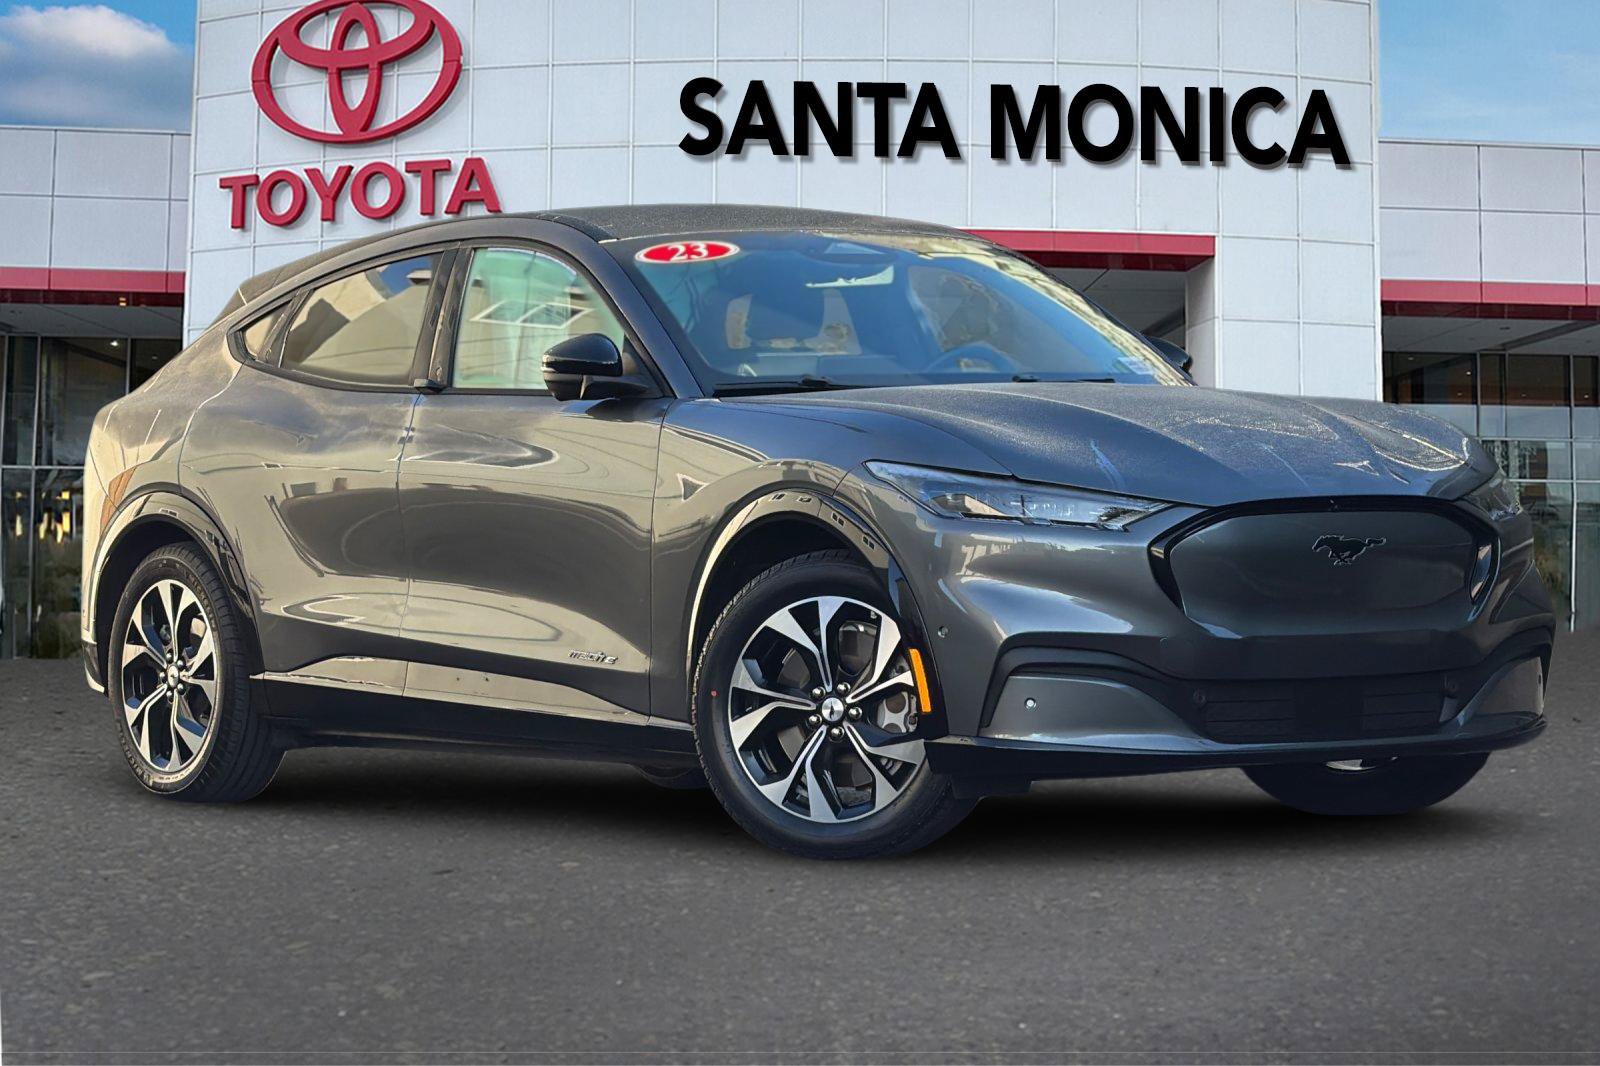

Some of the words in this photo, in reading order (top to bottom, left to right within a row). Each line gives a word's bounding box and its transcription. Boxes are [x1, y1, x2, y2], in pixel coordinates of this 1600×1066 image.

[678, 76, 961, 159] SANTA
[991, 83, 1351, 168] MONICA
[219, 157, 502, 229] TOYOTA
[667, 241, 709, 261] 23
